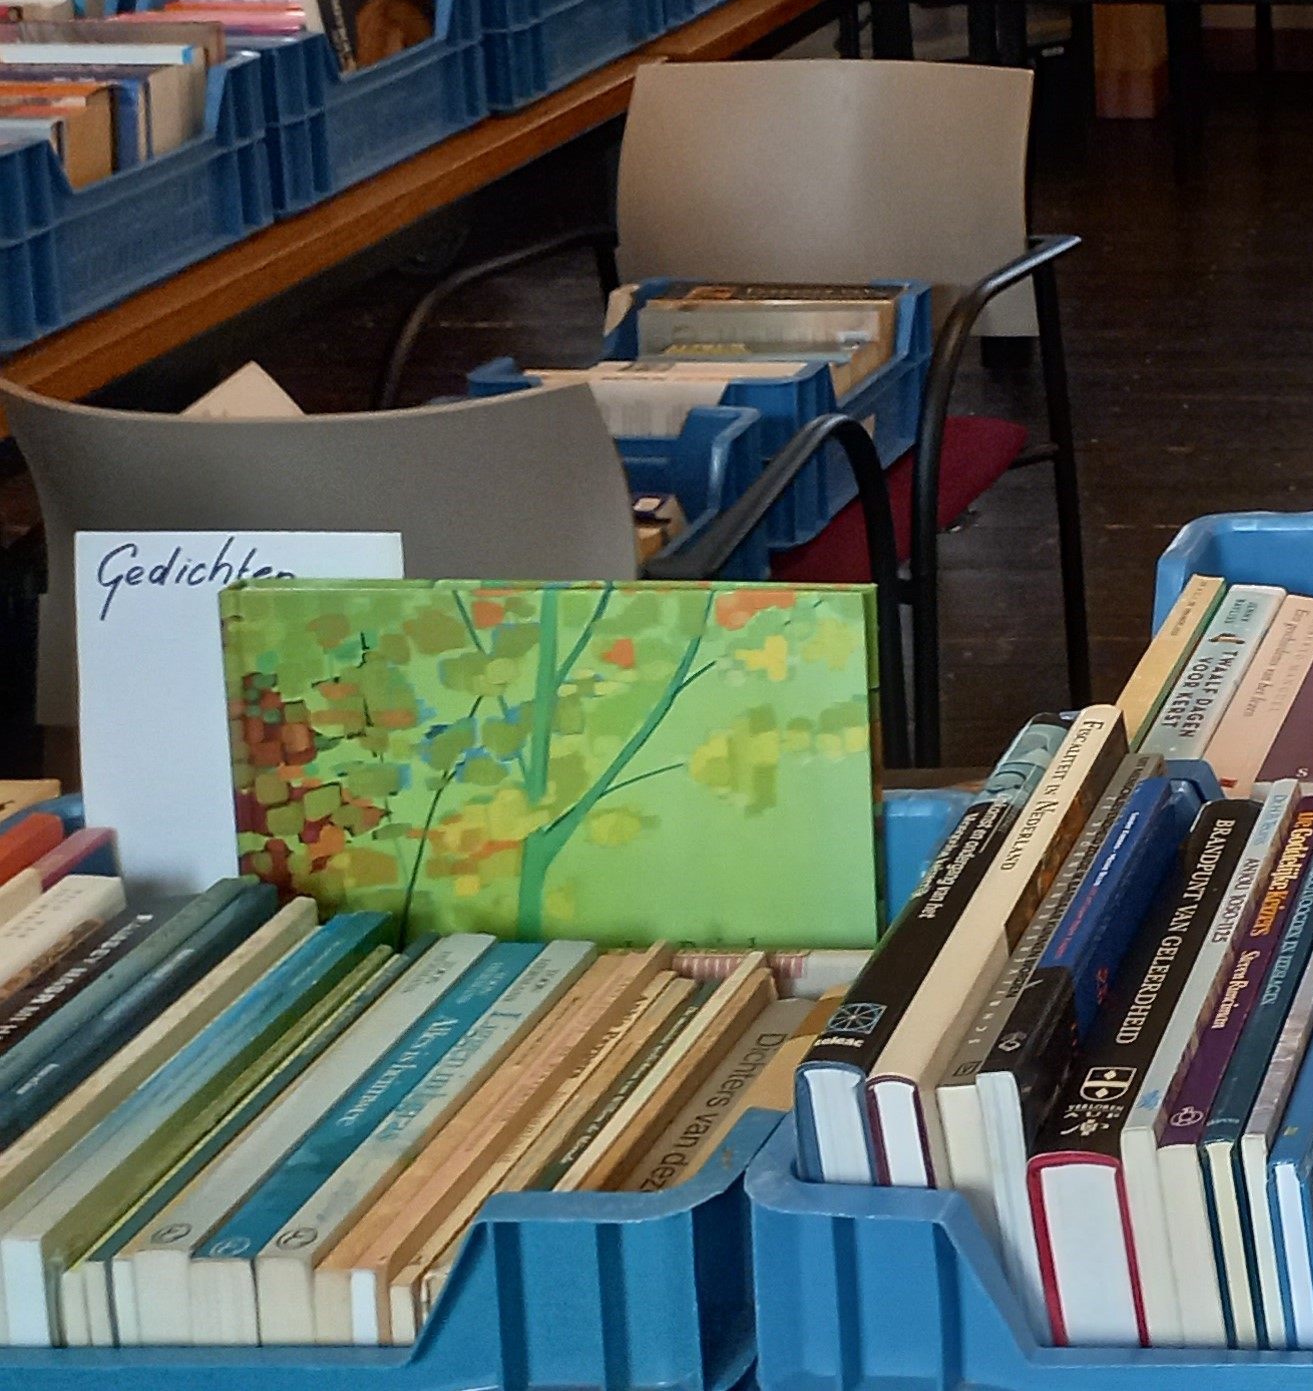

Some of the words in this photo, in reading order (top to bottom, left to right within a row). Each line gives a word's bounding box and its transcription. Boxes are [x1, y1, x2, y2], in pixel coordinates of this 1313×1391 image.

[1180, 655, 1214, 688] VOOR
[1199, 649, 1239, 694] TWAALF
[1158, 691, 1195, 729] KERST
[1175, 697, 1215, 738] DAGEN
[1049, 717, 1105, 782] FISCALITEIT
[996, 798, 1060, 873] NEDERLAND
[1178, 818, 1236, 901] BRANDPUNT
[1163, 903, 1199, 933] VAN
[1247, 890, 1291, 936] Keizers
[75, 912, 159, 965] RAMSEY
[25, 965, 93, 1003] NASR
[1112, 934, 1186, 1046] GELEERDHEID
[406, 1017, 463, 1048] Alles
[440, 1010, 523, 1067] Liggen
[704, 1033, 787, 1107] Dichters
[331, 1063, 419, 1126] heimwee
[671, 1112, 720, 1148] van
